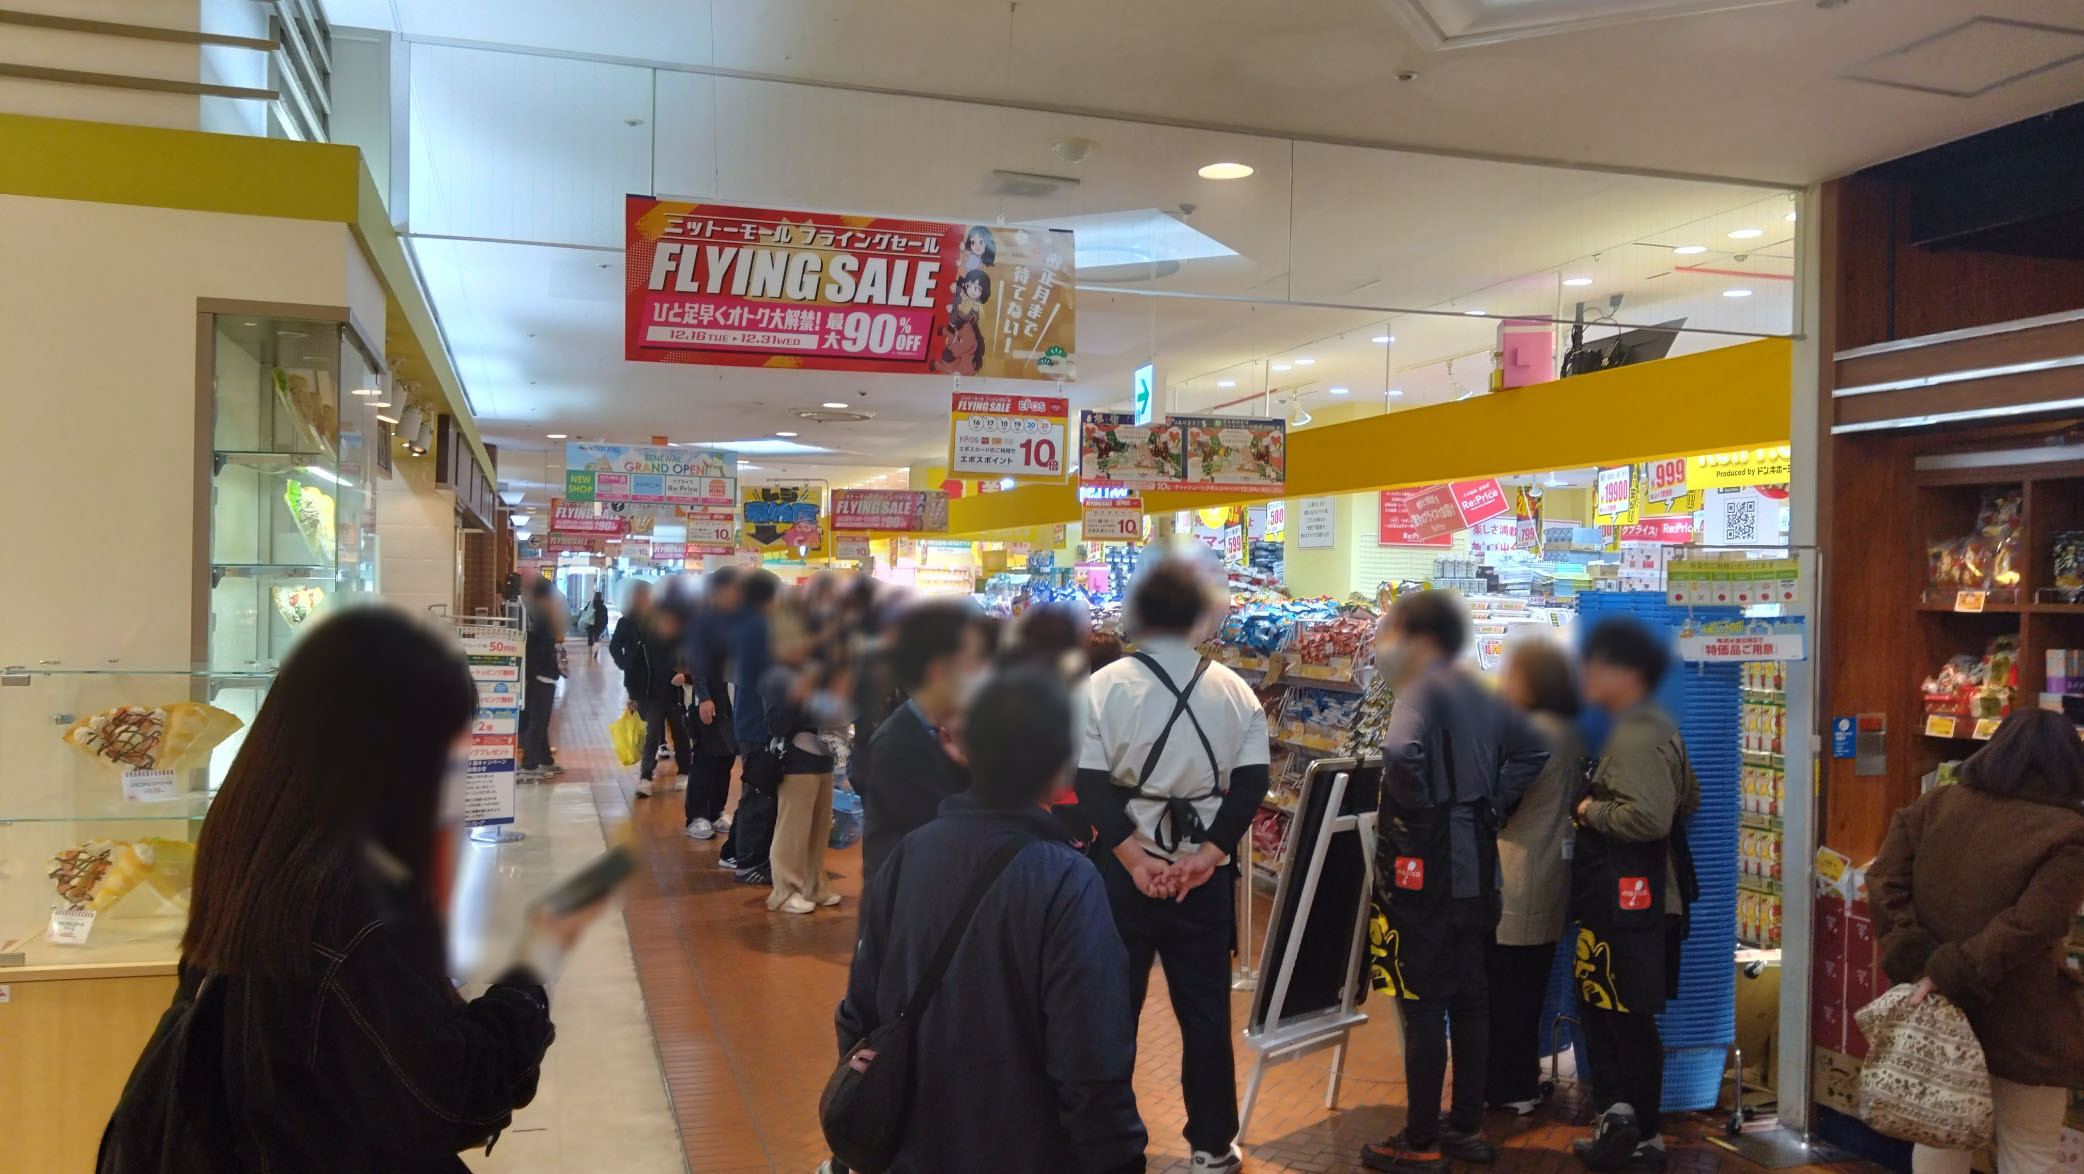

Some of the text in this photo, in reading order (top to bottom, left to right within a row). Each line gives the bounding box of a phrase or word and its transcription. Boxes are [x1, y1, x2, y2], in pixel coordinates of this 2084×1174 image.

[664, 219, 941, 254] ニットーモール フライングセール
[649, 242, 941, 308] FLYING SALE
[670, 330, 706, 341] 12.16
[842, 311, 898, 354] 90
[957, 399, 1046, 412] FLYING SALE EPOS
[960, 456, 1013, 465] エポスポイント
[624, 461, 705, 475] GRAND OPEN
[1716, 468, 1745, 477] Produced
[1747, 468, 1756, 476] by
[570, 475, 591, 483] NEW
[568, 485, 592, 493] SHOP
[1461, 489, 1499, 511] Re:Price
[836, 500, 912, 514] FLYING SALE
[1663, 521, 1693, 534] Re:Pric
[1705, 644, 1774, 656] 特価品ご用意
